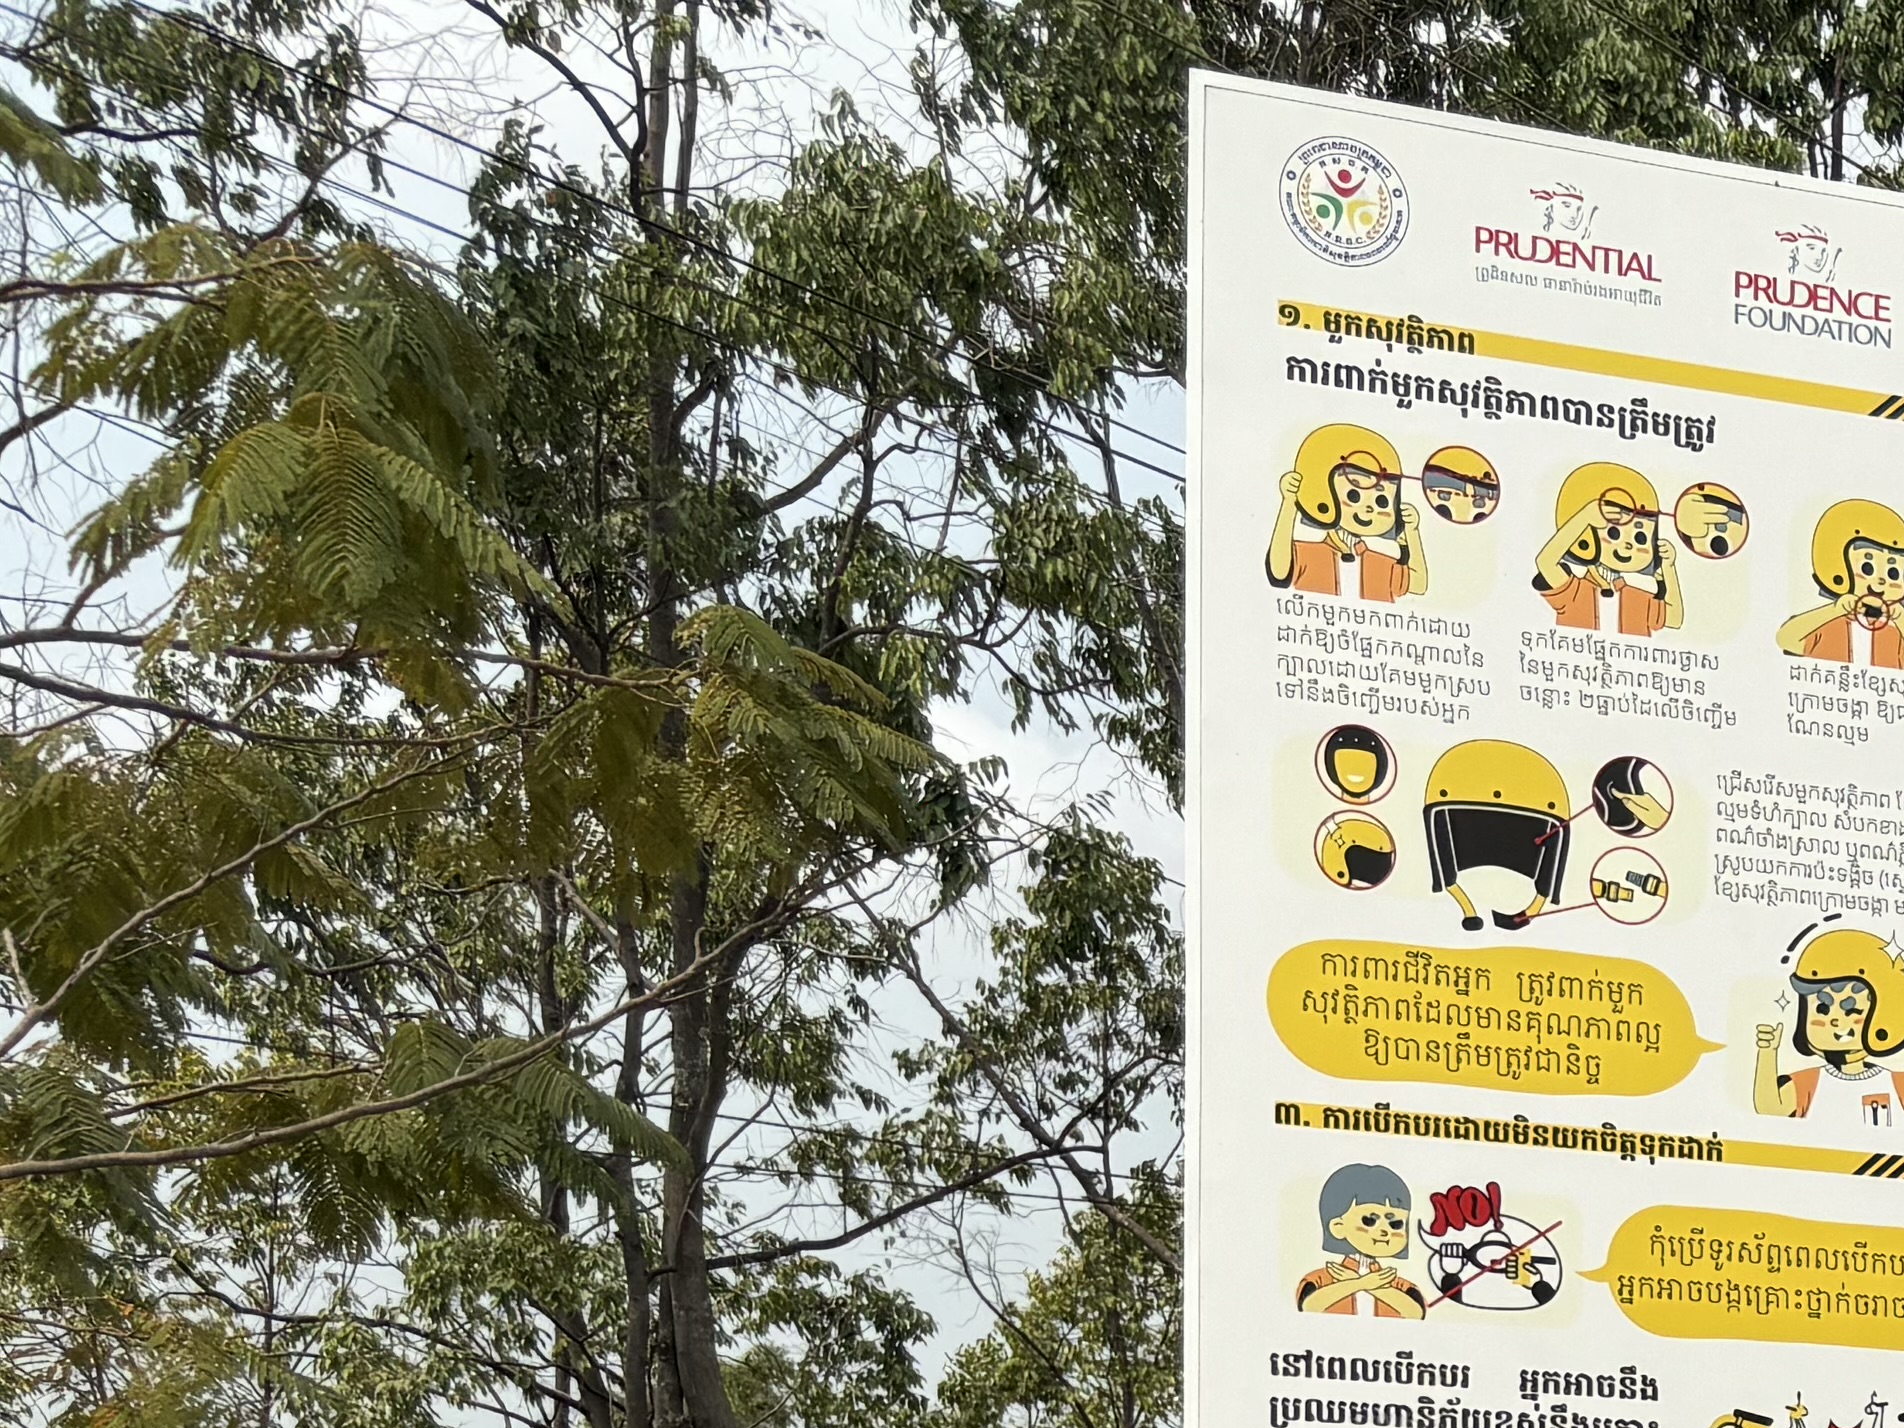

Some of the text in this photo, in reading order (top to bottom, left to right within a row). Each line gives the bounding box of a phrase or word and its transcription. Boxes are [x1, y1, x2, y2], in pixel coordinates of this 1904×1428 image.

[1475, 226, 1662, 284] PRUDENTIAL
[1735, 269, 1891, 323] PRUDENCE
[1735, 303, 1891, 349] FOUNDATION
[1430, 1182, 1504, 1236] NO!
